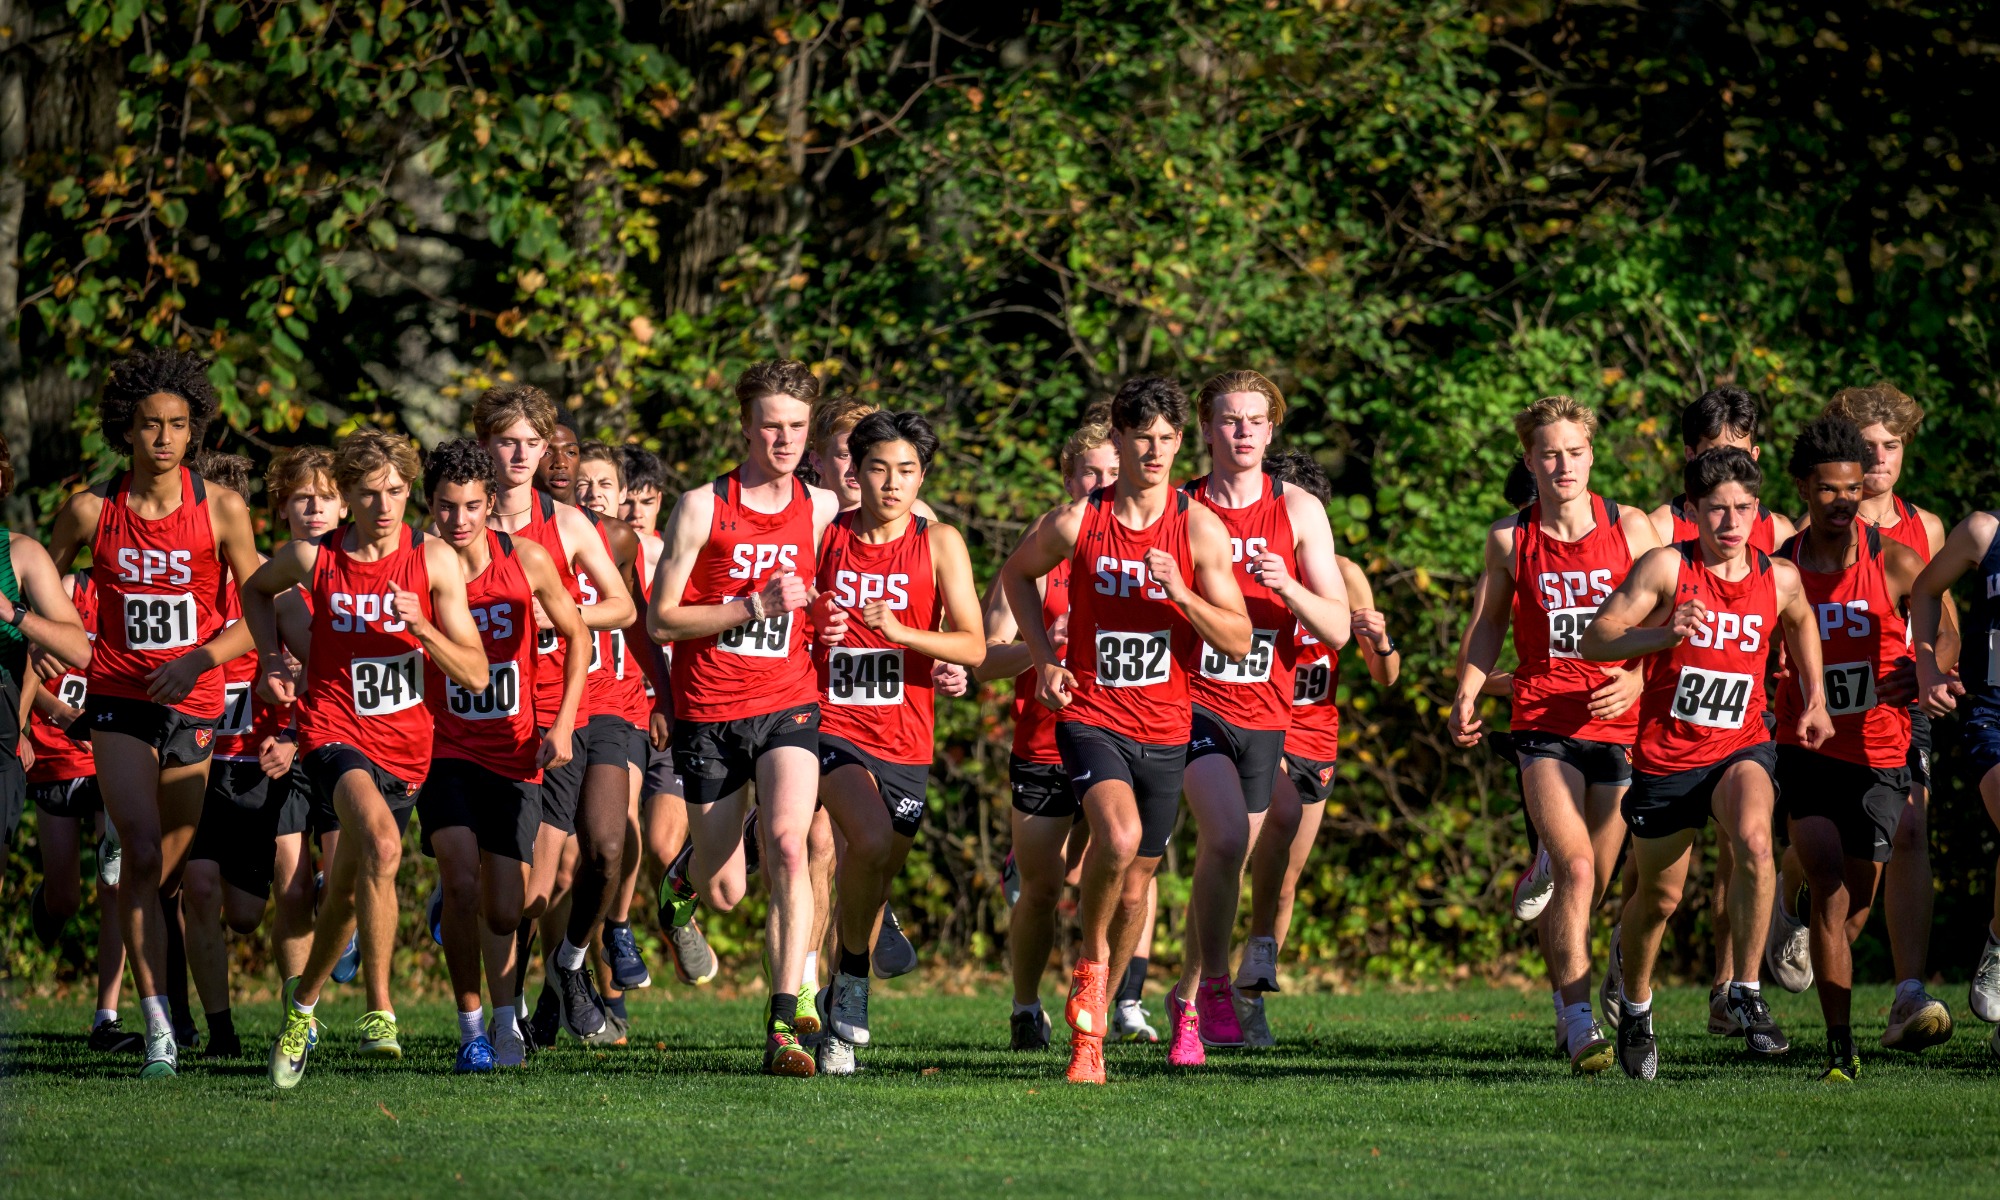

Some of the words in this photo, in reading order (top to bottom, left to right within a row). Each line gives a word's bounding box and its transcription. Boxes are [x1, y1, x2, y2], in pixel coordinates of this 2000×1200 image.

[118, 547, 192, 585] SPS
[728, 543, 798, 579] SPS
[1231, 537, 1269, 574] PS
[834, 570, 909, 610] SPS
[1538, 568, 1613, 610] SPS
[127, 599, 189, 644] 331
[330, 592, 406, 633] SPS
[471, 603, 513, 640] PS
[1553, 613, 1597, 653] 35
[1689, 610, 1763, 652] SPS
[1811, 599, 1871, 640] PS
[832, 652, 900, 699] 346
[1099, 636, 1167, 681] 332
[356, 657, 417, 709] 341
[1294, 663, 1328, 700] 69
[1676, 673, 1745, 722] 344
[1825, 665, 1870, 709] 67
[896, 797, 924, 818] SPS
